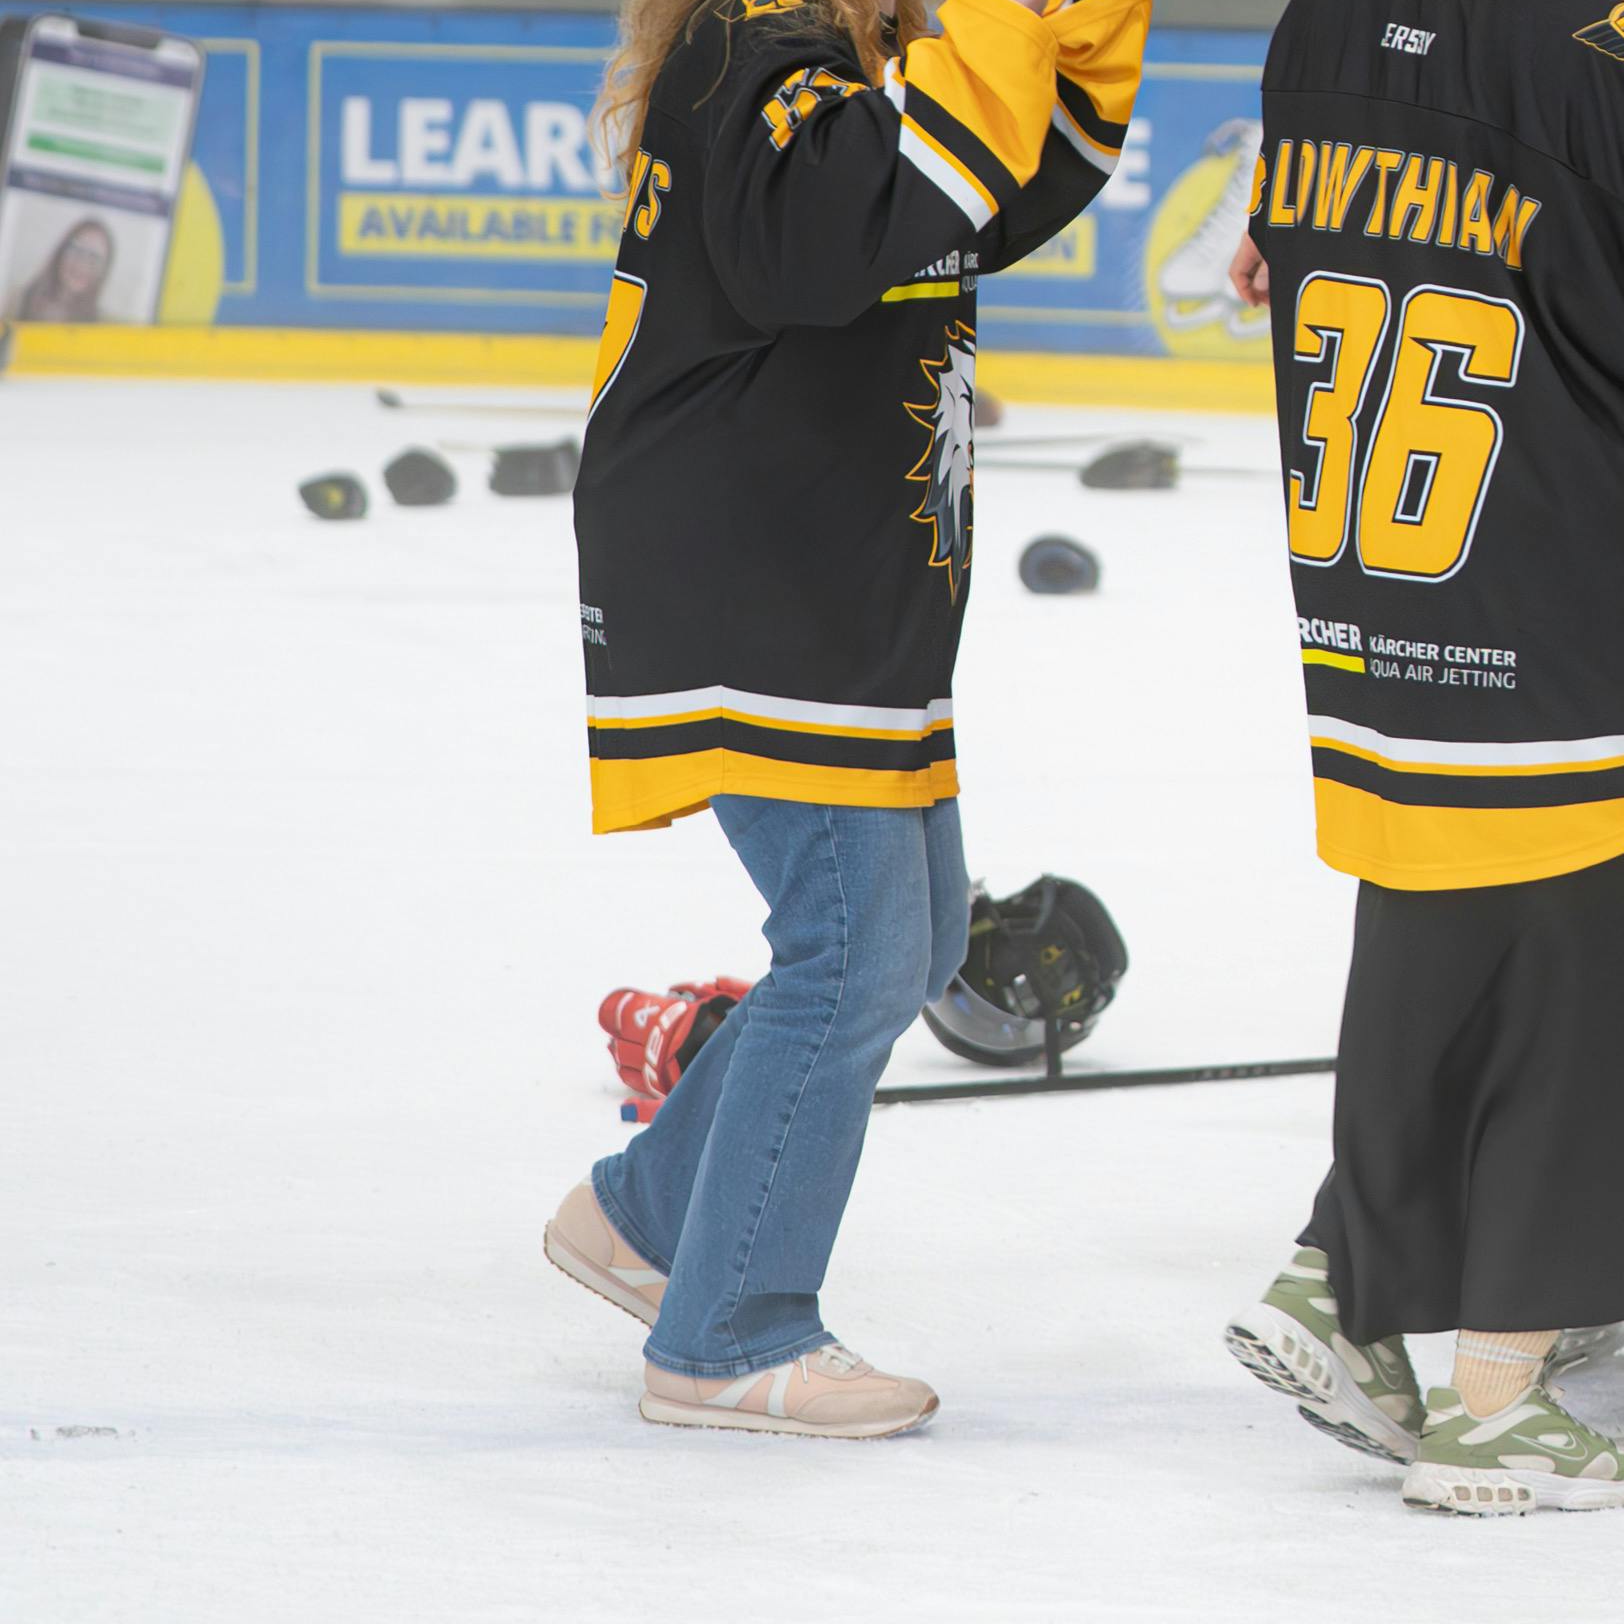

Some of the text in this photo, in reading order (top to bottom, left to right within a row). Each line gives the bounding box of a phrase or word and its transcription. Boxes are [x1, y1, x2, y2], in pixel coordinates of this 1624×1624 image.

[358, 204, 578, 244] AVAILABLE
[1289, 270, 1525, 583] 36
[1369, 633, 1517, 667] KÄRCHER CENTER
[1405, 663, 1433, 683] AIR
[1438, 667, 1517, 690] JETTING
